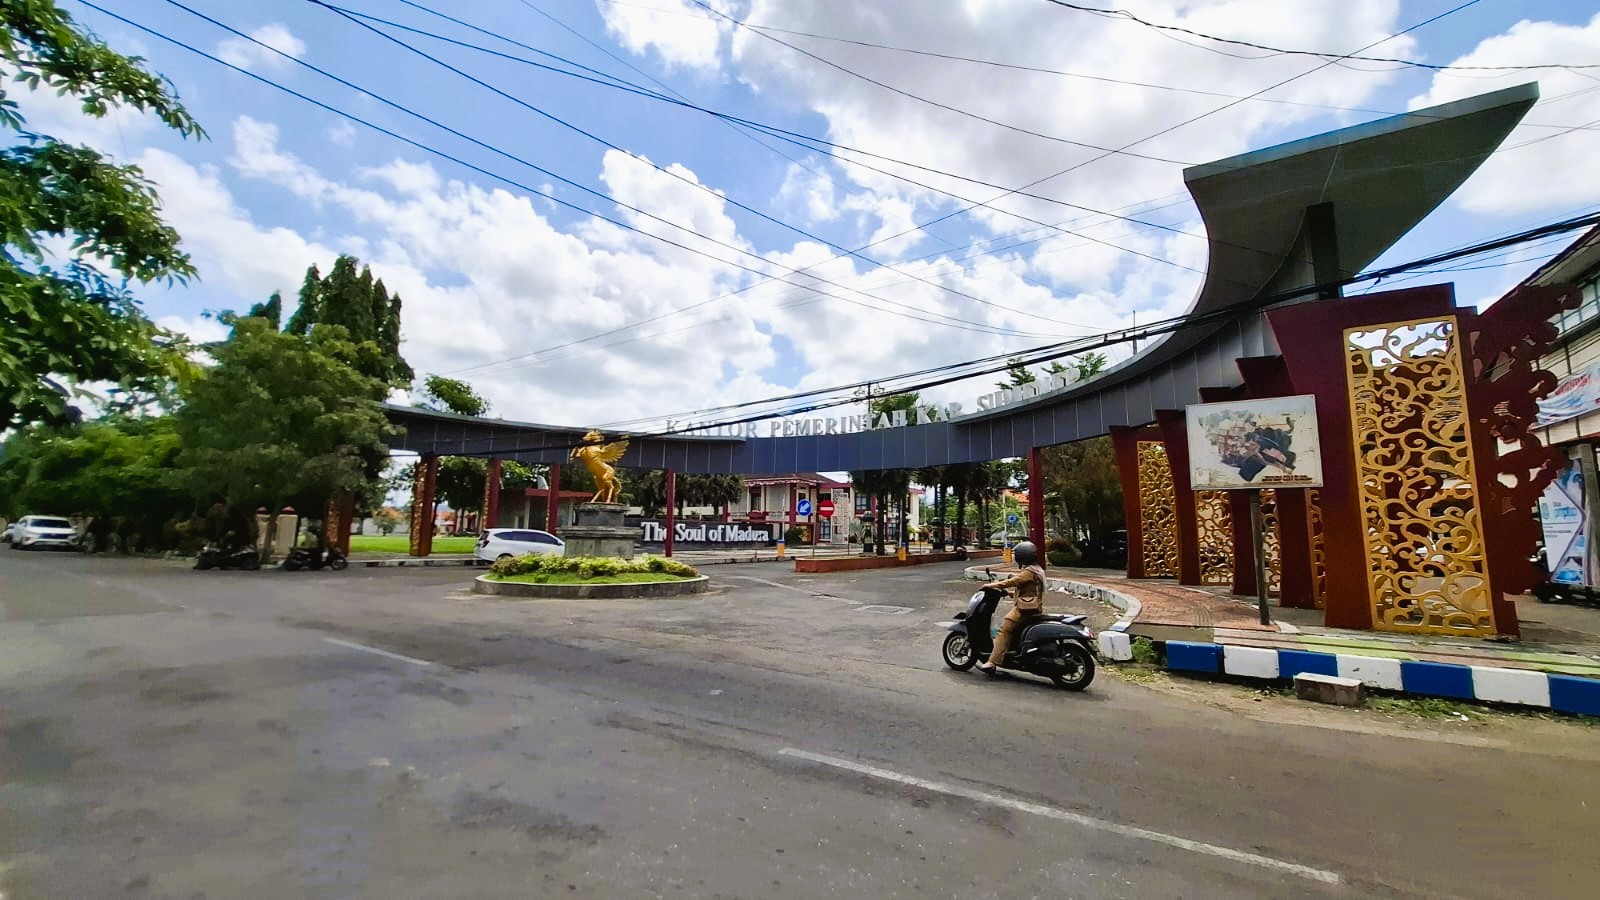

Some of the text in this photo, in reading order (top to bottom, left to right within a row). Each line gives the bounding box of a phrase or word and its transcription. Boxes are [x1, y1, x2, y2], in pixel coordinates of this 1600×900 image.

[666, 420, 758, 438] KANTOR
[771, 410, 908, 437] PEMERINTAH
[675, 523, 706, 542] Soul
[708, 523, 725, 542] of
[725, 525, 769, 542] Madura
